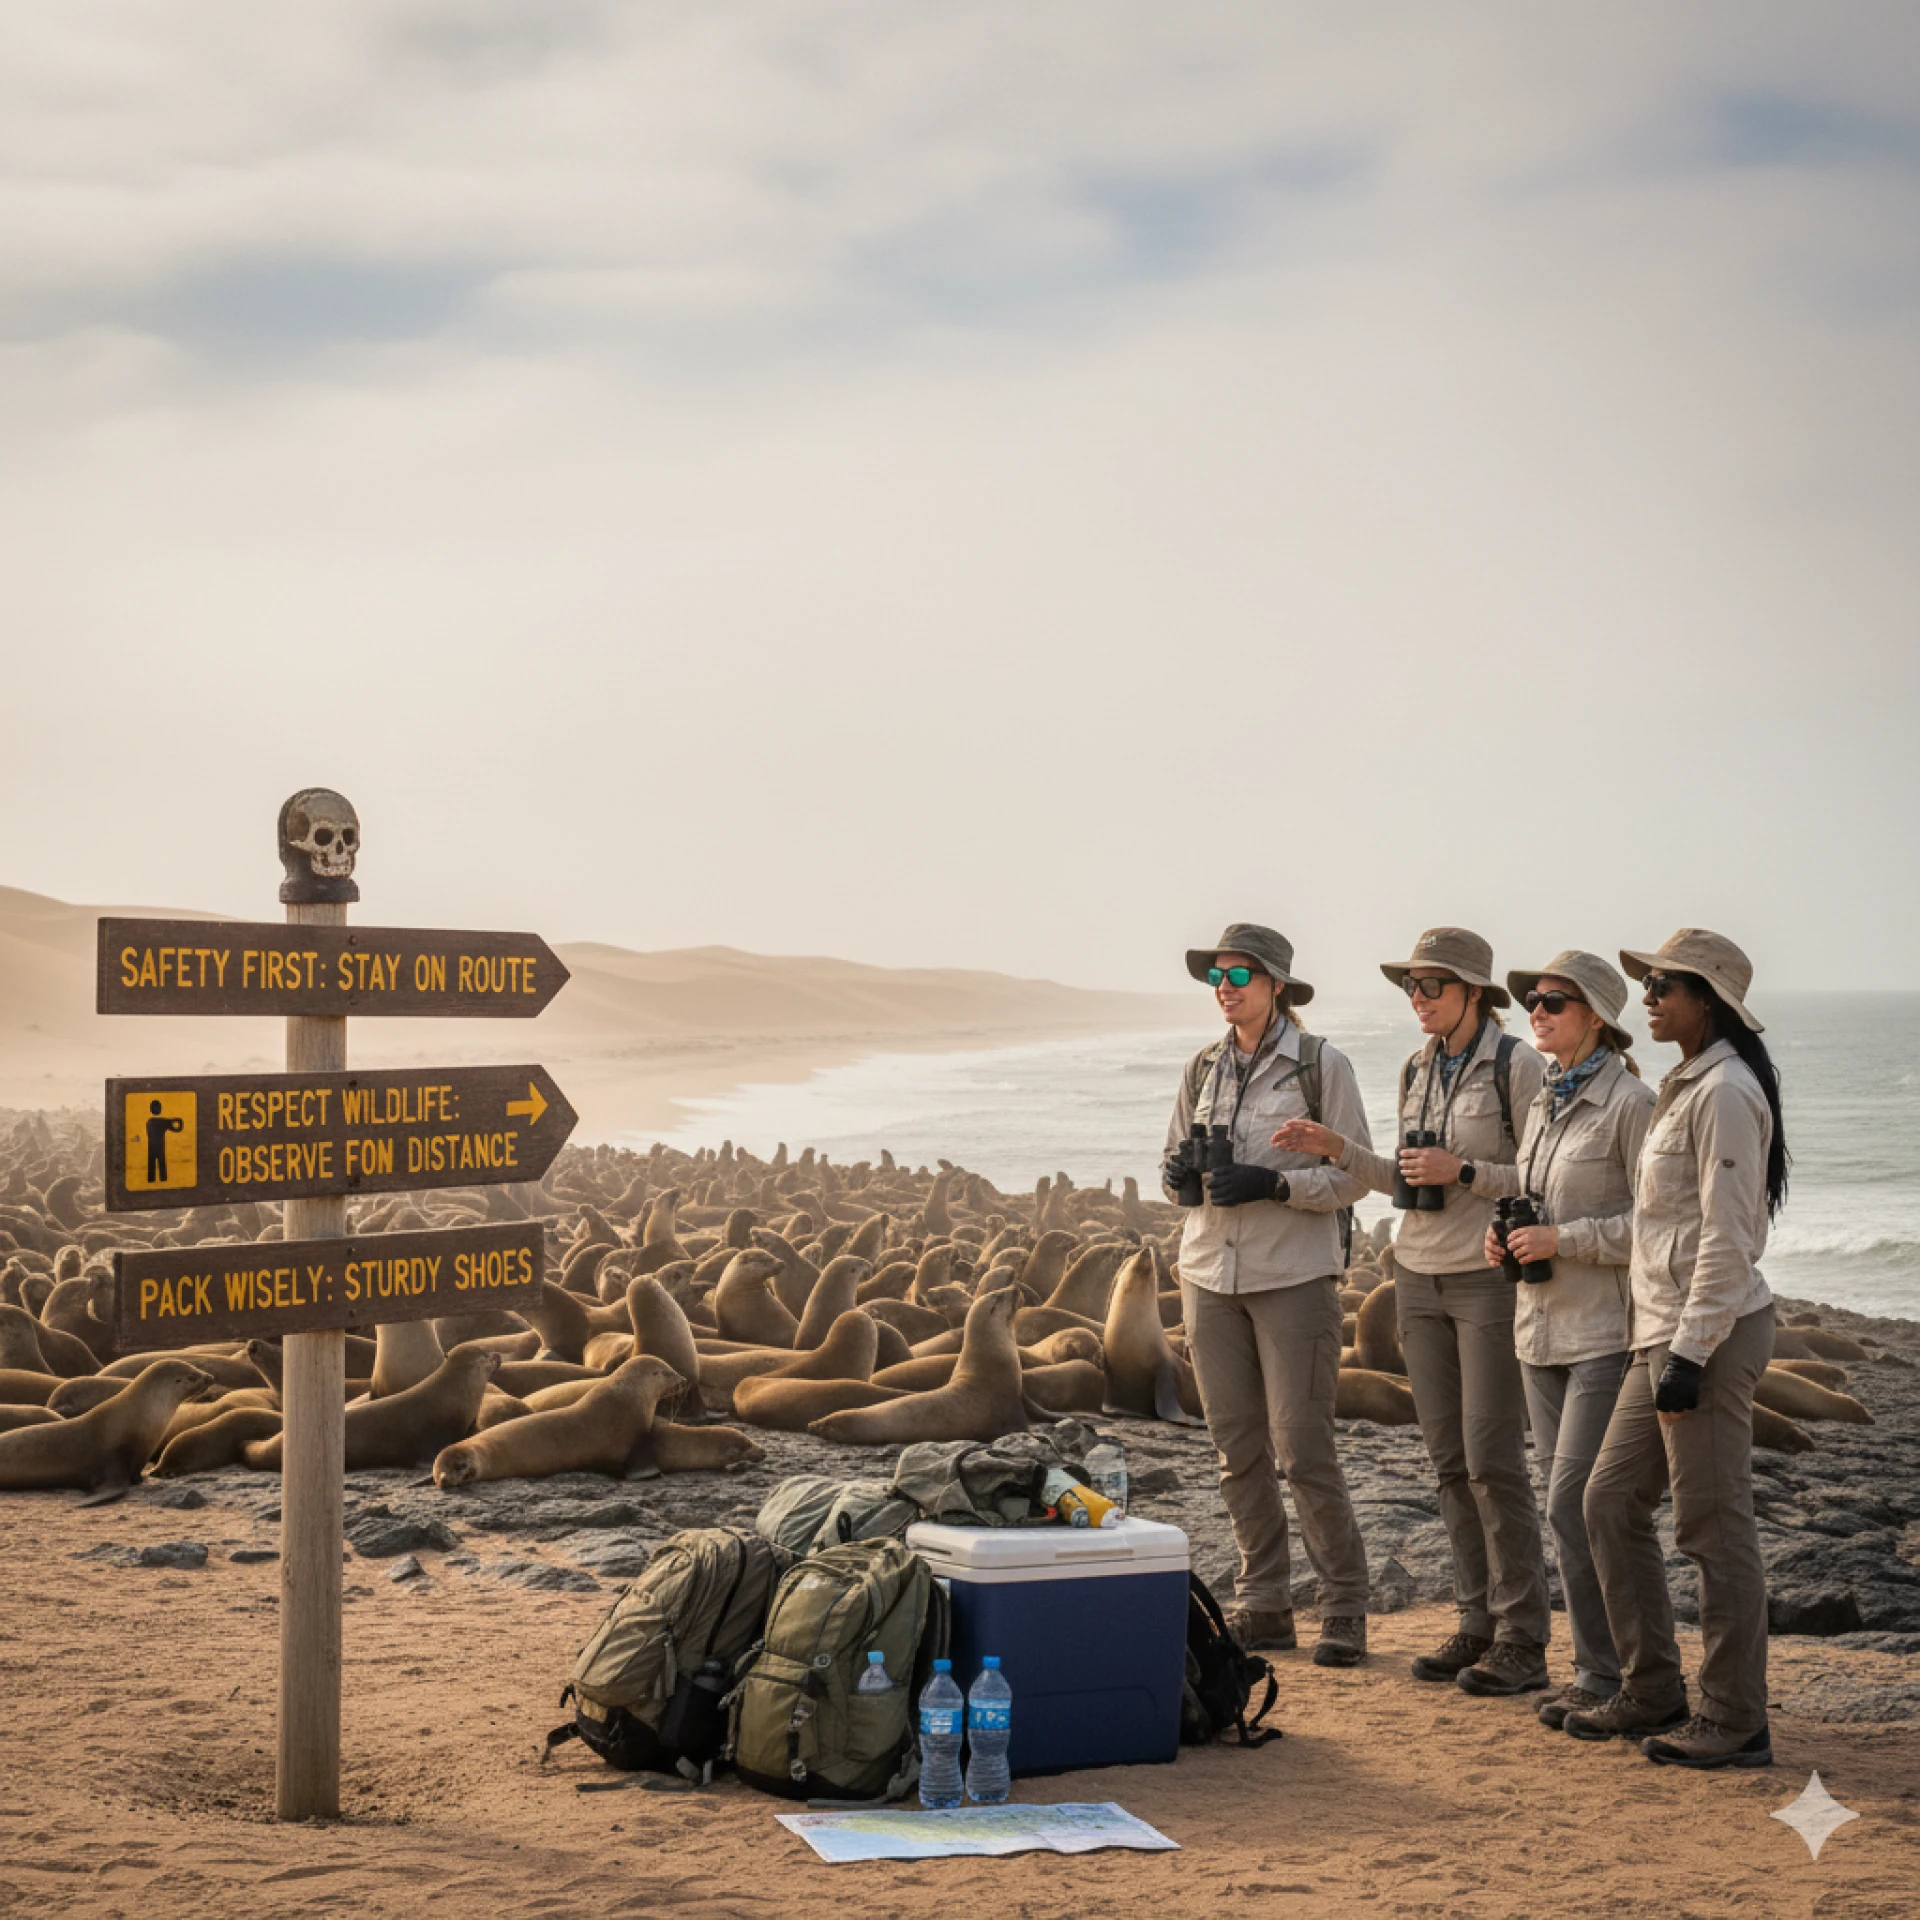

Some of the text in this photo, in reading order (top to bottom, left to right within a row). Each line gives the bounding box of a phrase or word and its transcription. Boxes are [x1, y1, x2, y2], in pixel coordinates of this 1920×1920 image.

[120, 946, 538, 995] SAFETY FIRST: STAY ON ROUTE
[217, 1084, 460, 1131] RESPECT WILDLIFE:
[218, 1131, 519, 1184] OBSERVE FON DISTANCE
[140, 1247, 533, 1320] PACK WISELY: STURDY SHOES
